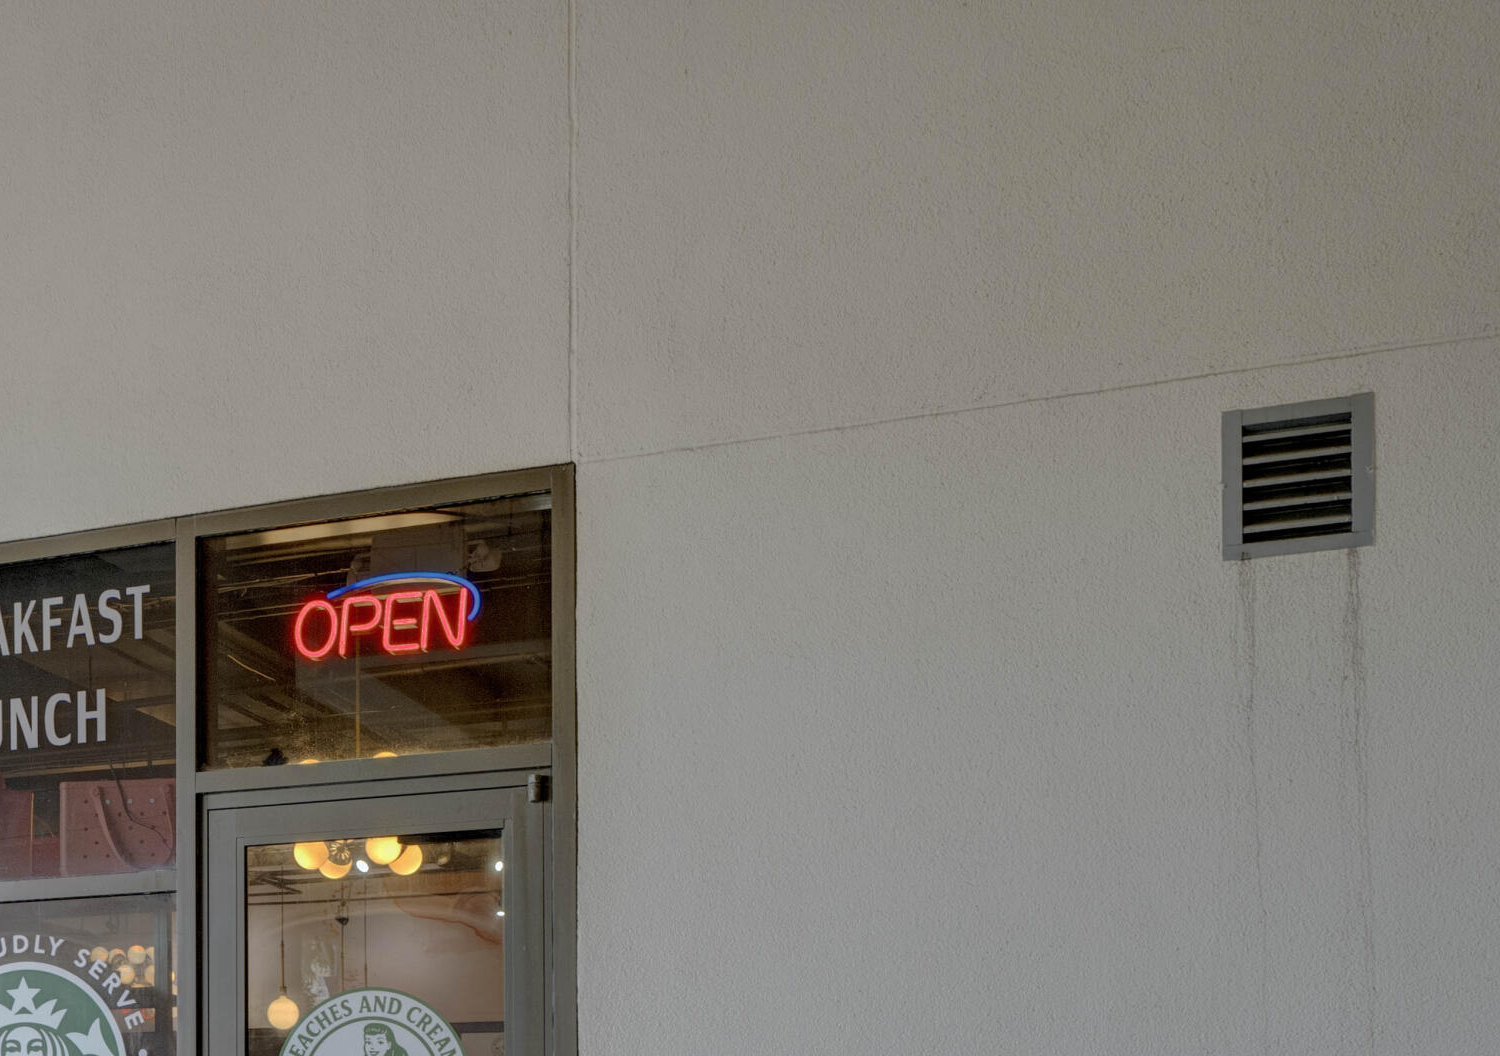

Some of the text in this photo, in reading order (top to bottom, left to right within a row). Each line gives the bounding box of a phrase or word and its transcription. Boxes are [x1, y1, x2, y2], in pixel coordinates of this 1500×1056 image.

[294, 587, 468, 659] OPEN
[73, 949, 145, 1031] SERVE
[359, 995, 403, 1015] AND
